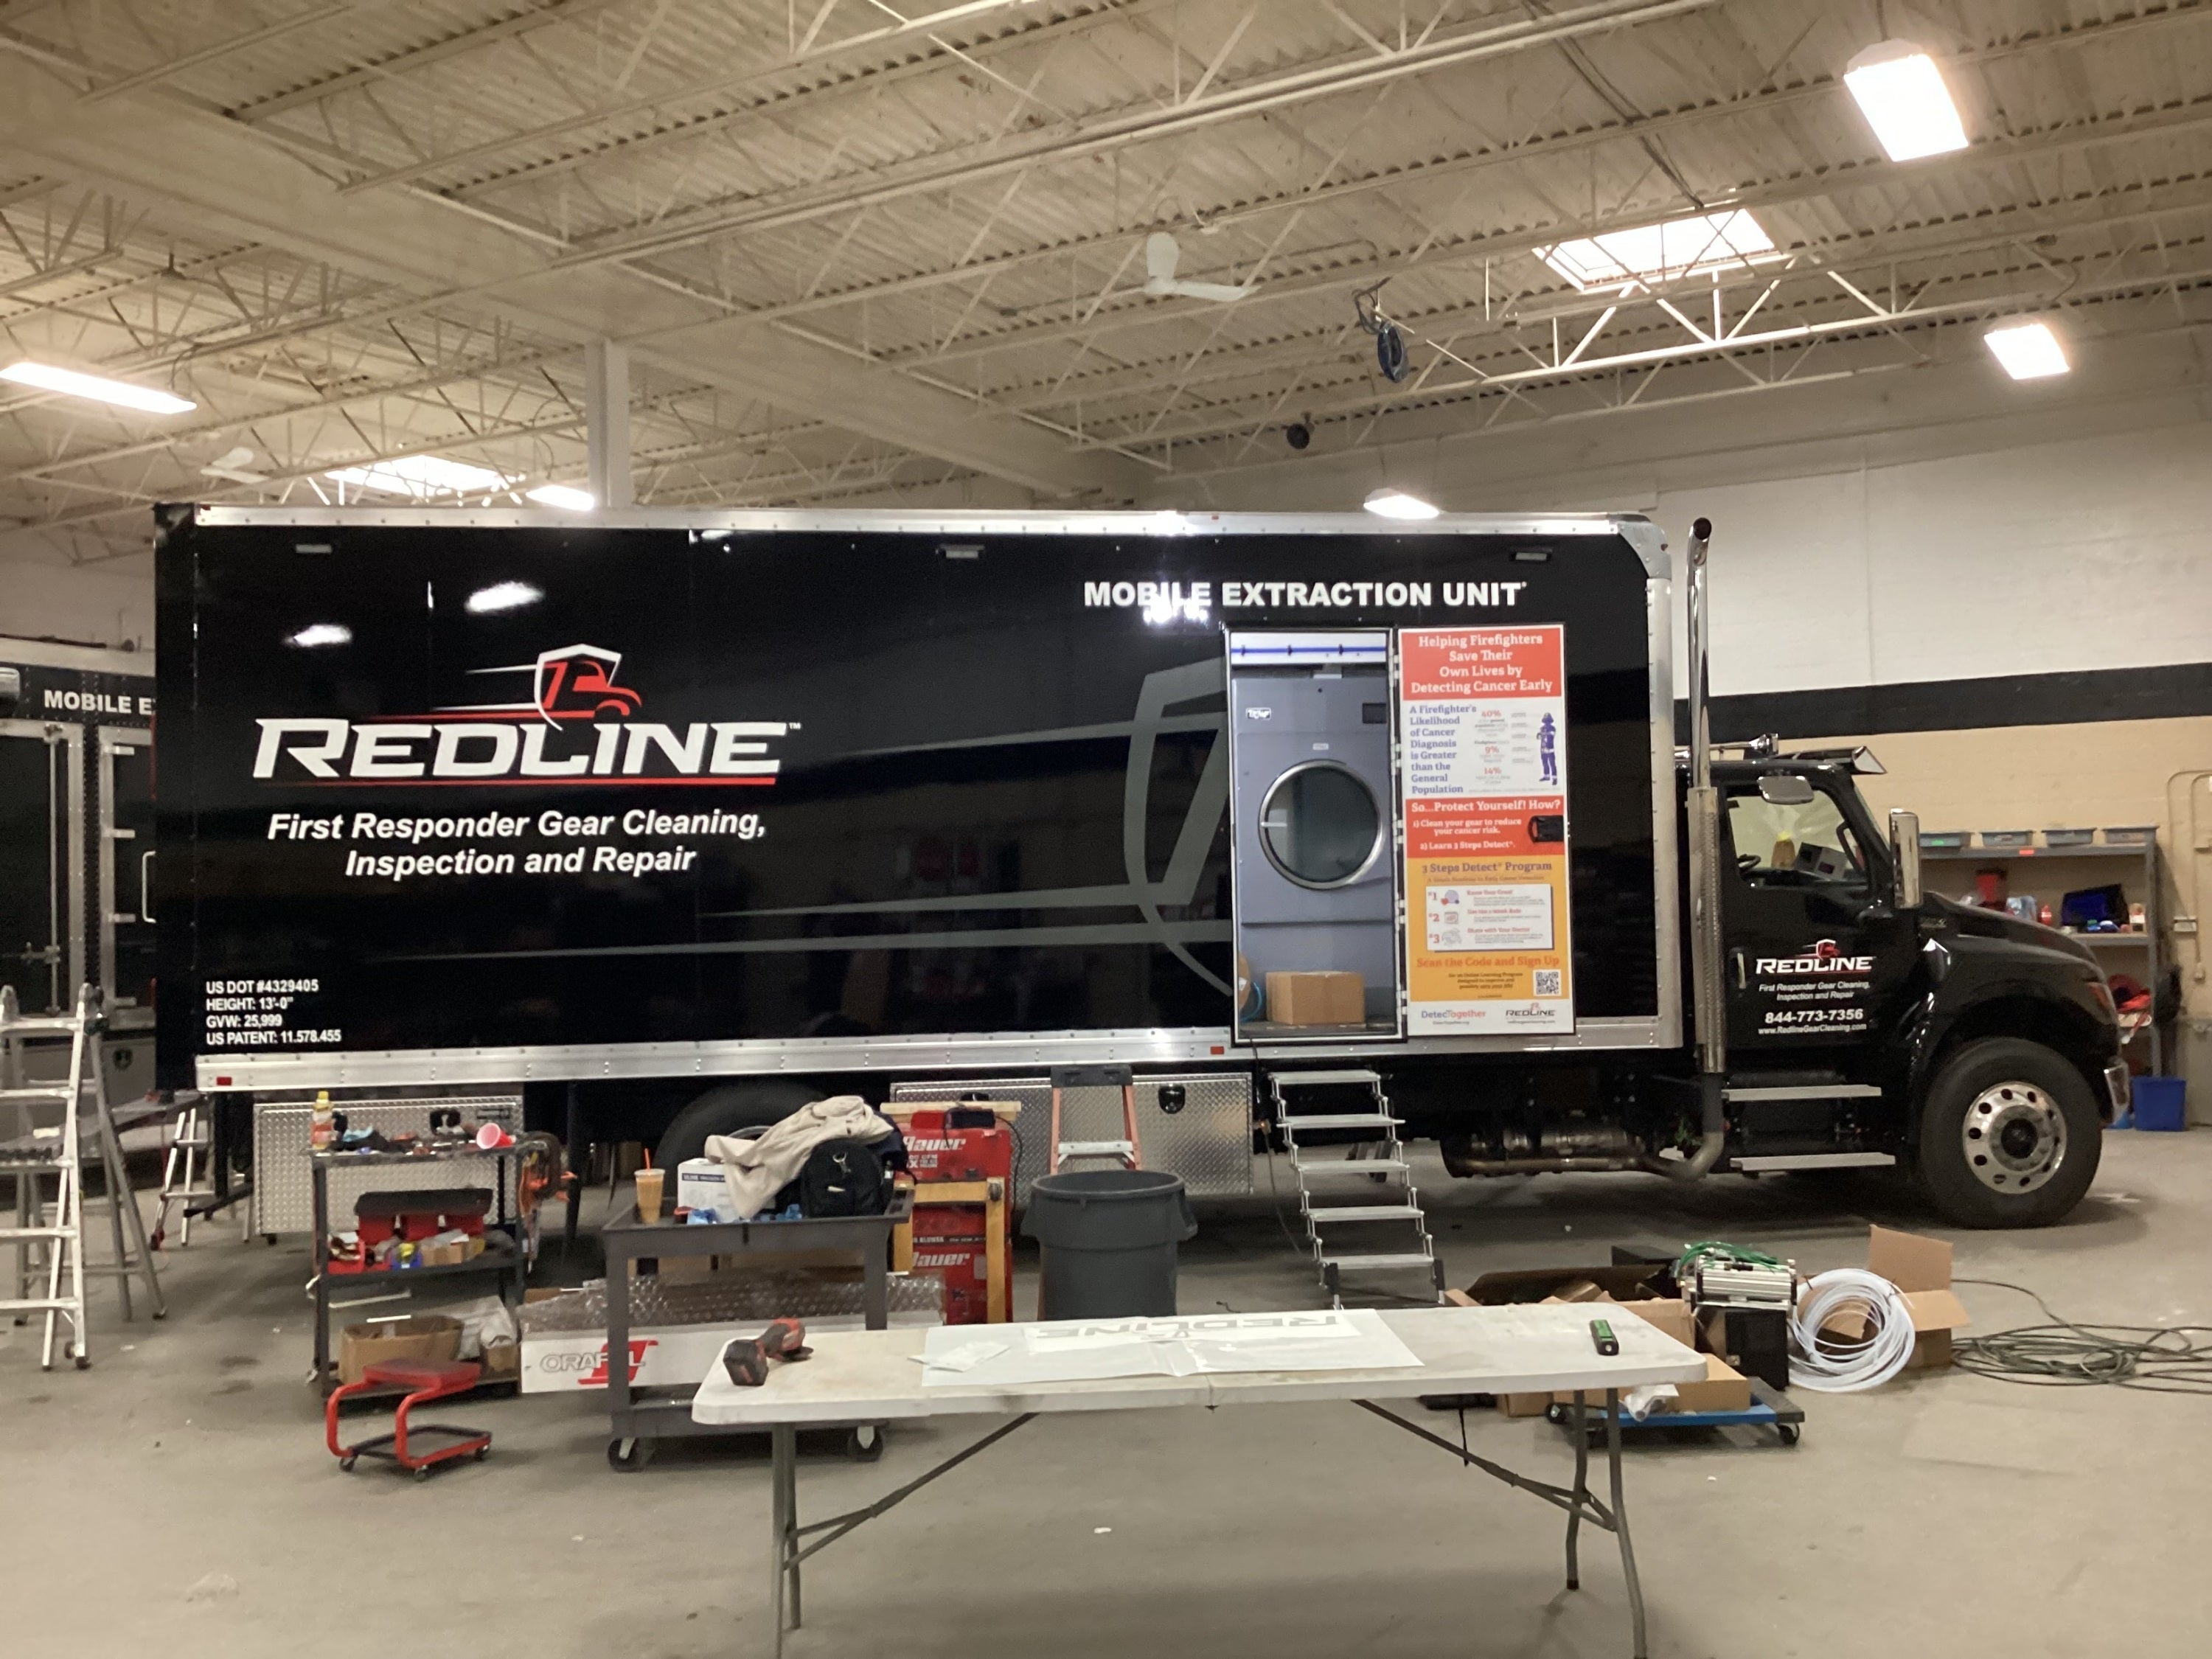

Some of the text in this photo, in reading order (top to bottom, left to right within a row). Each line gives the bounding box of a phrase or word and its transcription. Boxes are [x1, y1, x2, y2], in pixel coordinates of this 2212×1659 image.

[1084, 581, 1212, 607] MOBILE
[1222, 581, 1432, 607] EXTRACTION
[1419, 633, 1543, 649] Helping Firefighters
[1450, 649, 1513, 662] Save Their
[1439, 664, 1523, 678] Own Lives by
[1411, 679, 1553, 695] Detecting Cancer Early
[44, 689, 156, 716] MOBILE E
[1409, 704, 1477, 714] A Firefighter's
[1410, 716, 1461, 726] Likelihood
[1410, 728, 1455, 737] of Cancer
[1411, 740, 1457, 750] Diagnosis
[1420, 751, 1457, 759] Greater
[1411, 762, 1451, 771] than the
[1411, 773, 1448, 782] General
[1412, 785, 1464, 796] Population
[1476, 800, 1526, 811] Yourself!
[1528, 799, 1561, 810] How?
[268, 808, 766, 844] First Responder Gear Cleaning,
[1444, 820, 1463, 828] your
[1465, 820, 1484, 828] gear
[1433, 828, 1453, 836] your
[1459, 841, 1481, 850] Steps
[345, 845, 697, 882] Inspection and Repair
[1430, 863, 1460, 874] Steps
[1505, 862, 1552, 873] Program
[1417, 955, 1560, 968] Scan the Code and Sign Up
[205, 978, 319, 994] US DOT #4329405
[1759, 981, 1871, 992] First Responder Gear Cleaning,
[1777, 992, 1814, 1001] Inspection
[1830, 991, 1854, 999] Repair
[206, 997, 256, 1012] HEIGHT:
[1421, 1009, 1486, 1020] DetecTogether
[1764, 1009, 1864, 1024] 844-773-7356
[206, 1014, 282, 1028] GVW: 25,999
[206, 1029, 342, 1045] US PATENT: 11.578.455
[913, 1251, 970, 1267] auer
[540, 1351, 646, 1373] ORAFL
